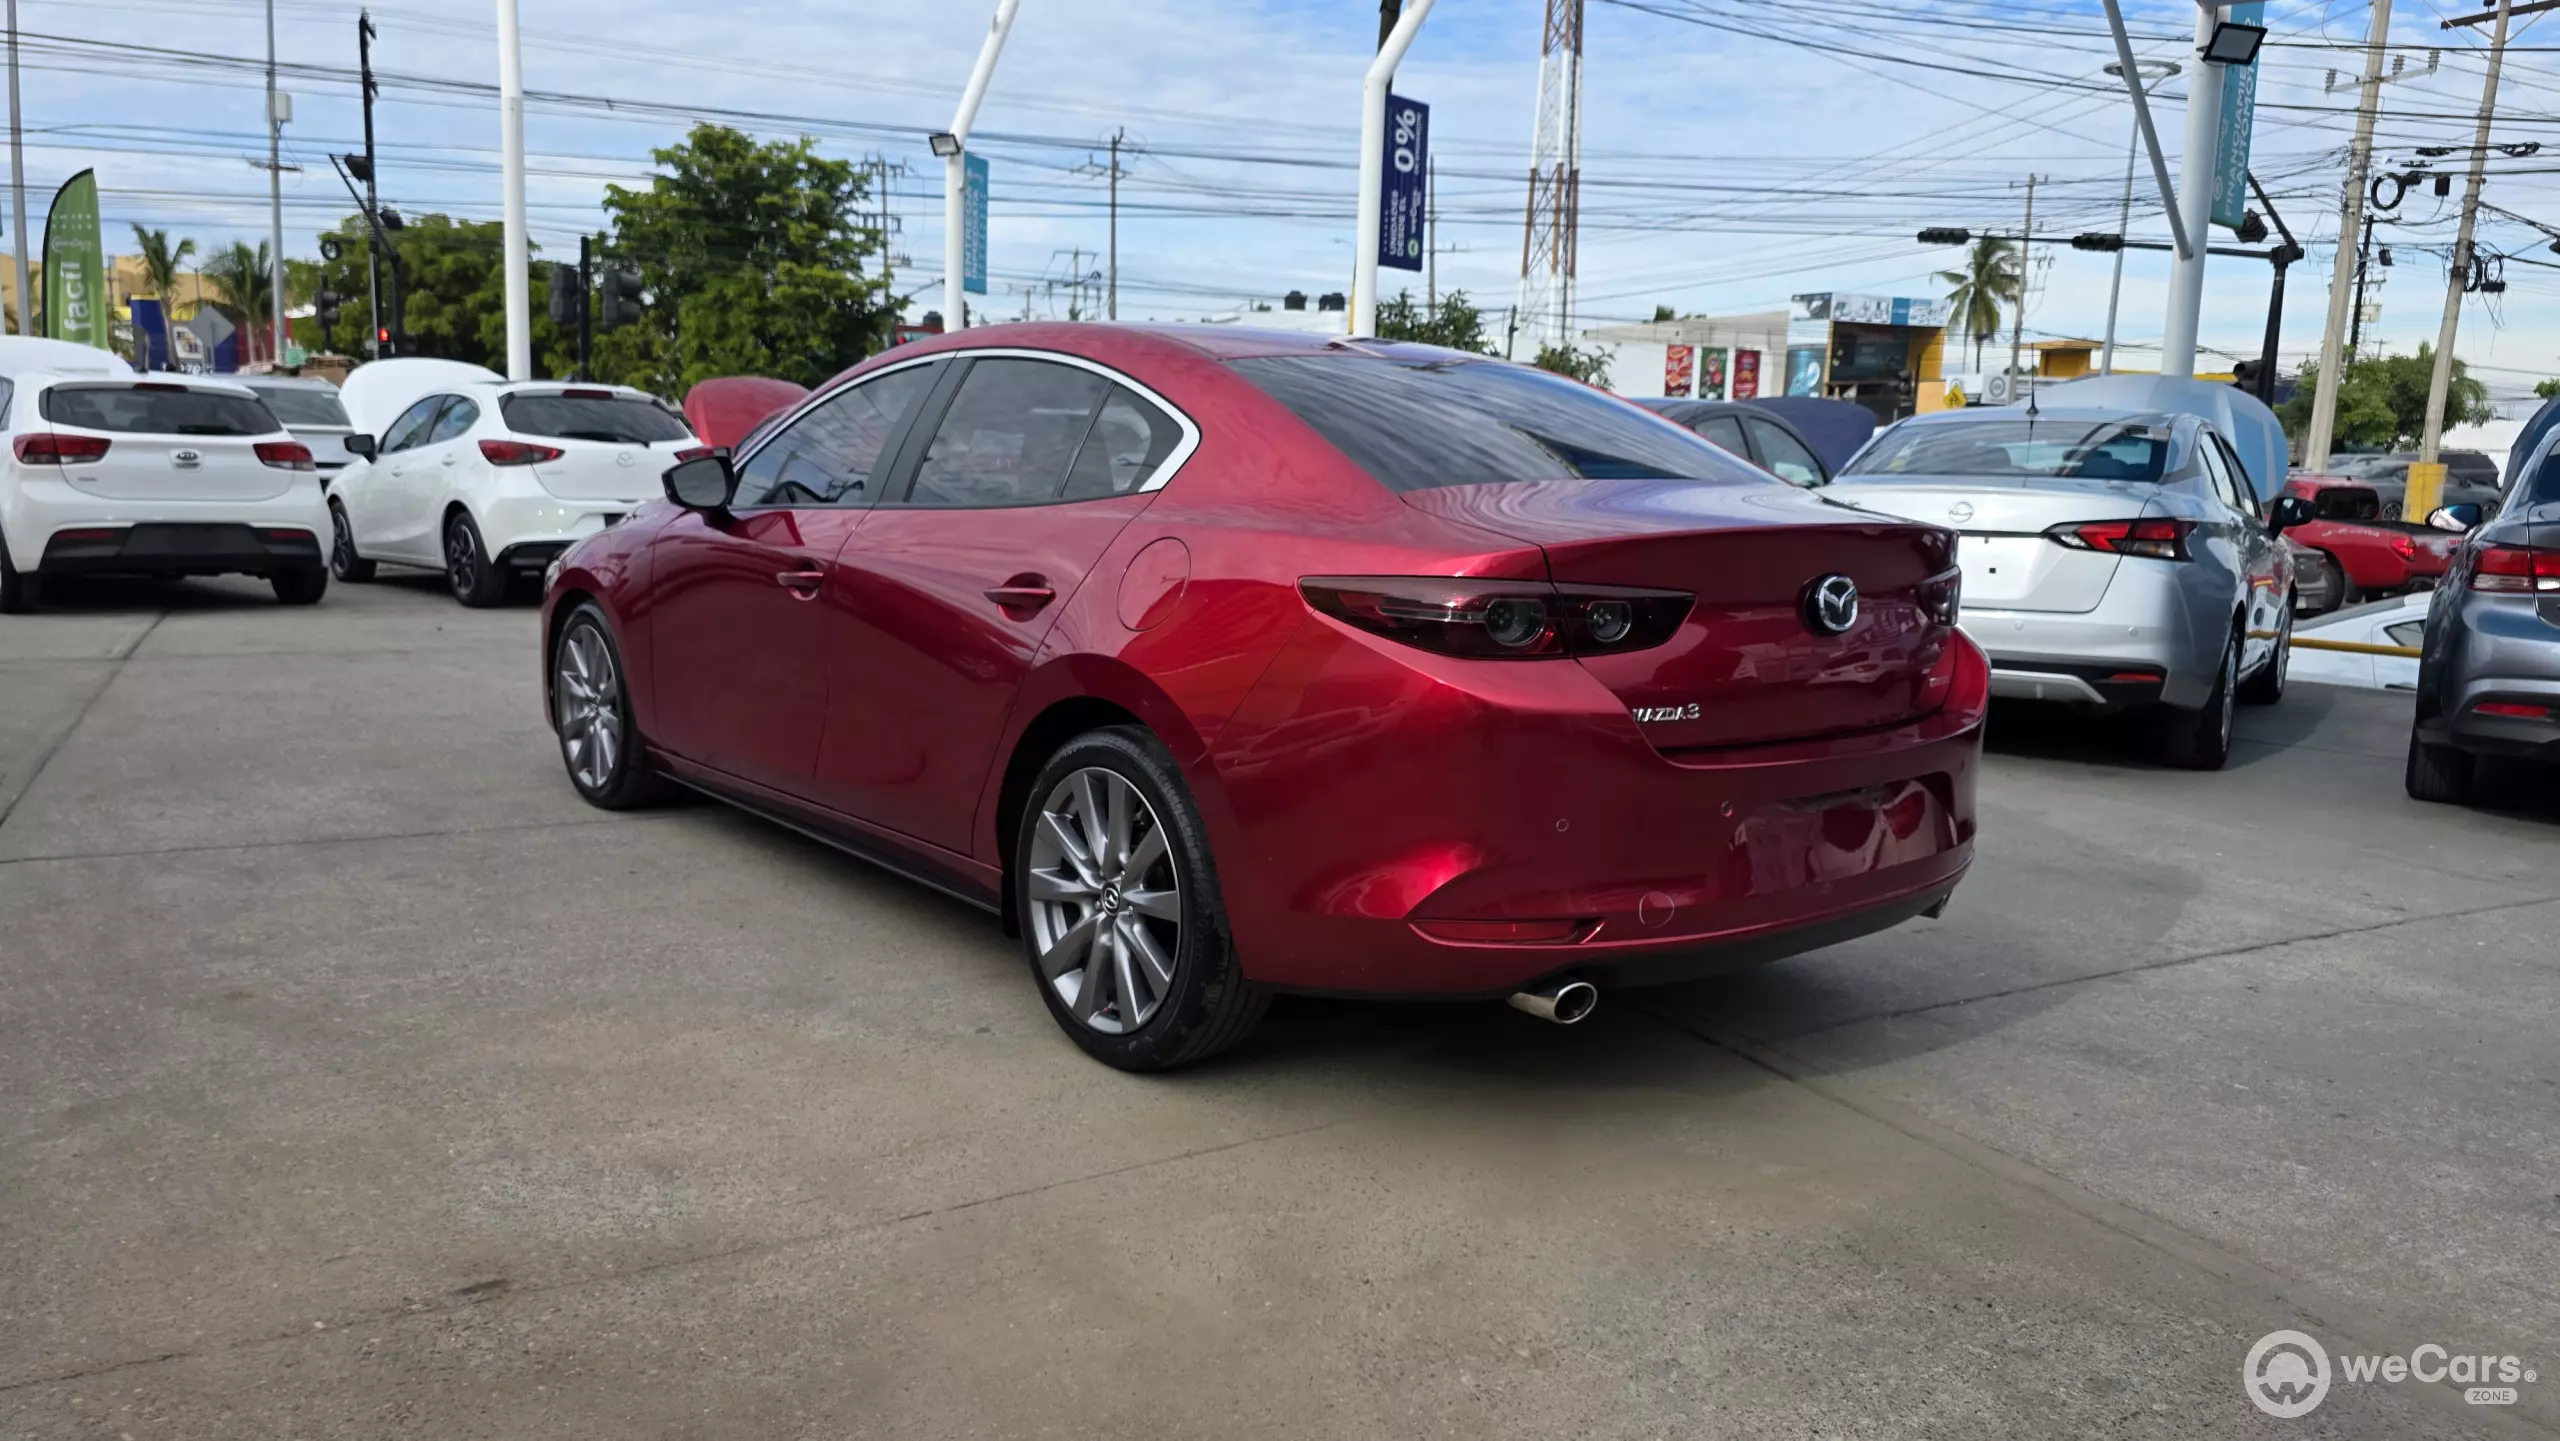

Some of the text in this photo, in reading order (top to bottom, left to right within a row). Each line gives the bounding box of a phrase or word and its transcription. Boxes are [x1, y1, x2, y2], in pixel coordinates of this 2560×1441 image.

[1394, 108, 1416, 174] 0%
[2224, 17, 2252, 217] FINANCIAMIE
[2236, 21, 2260, 187] AUTOMOT
